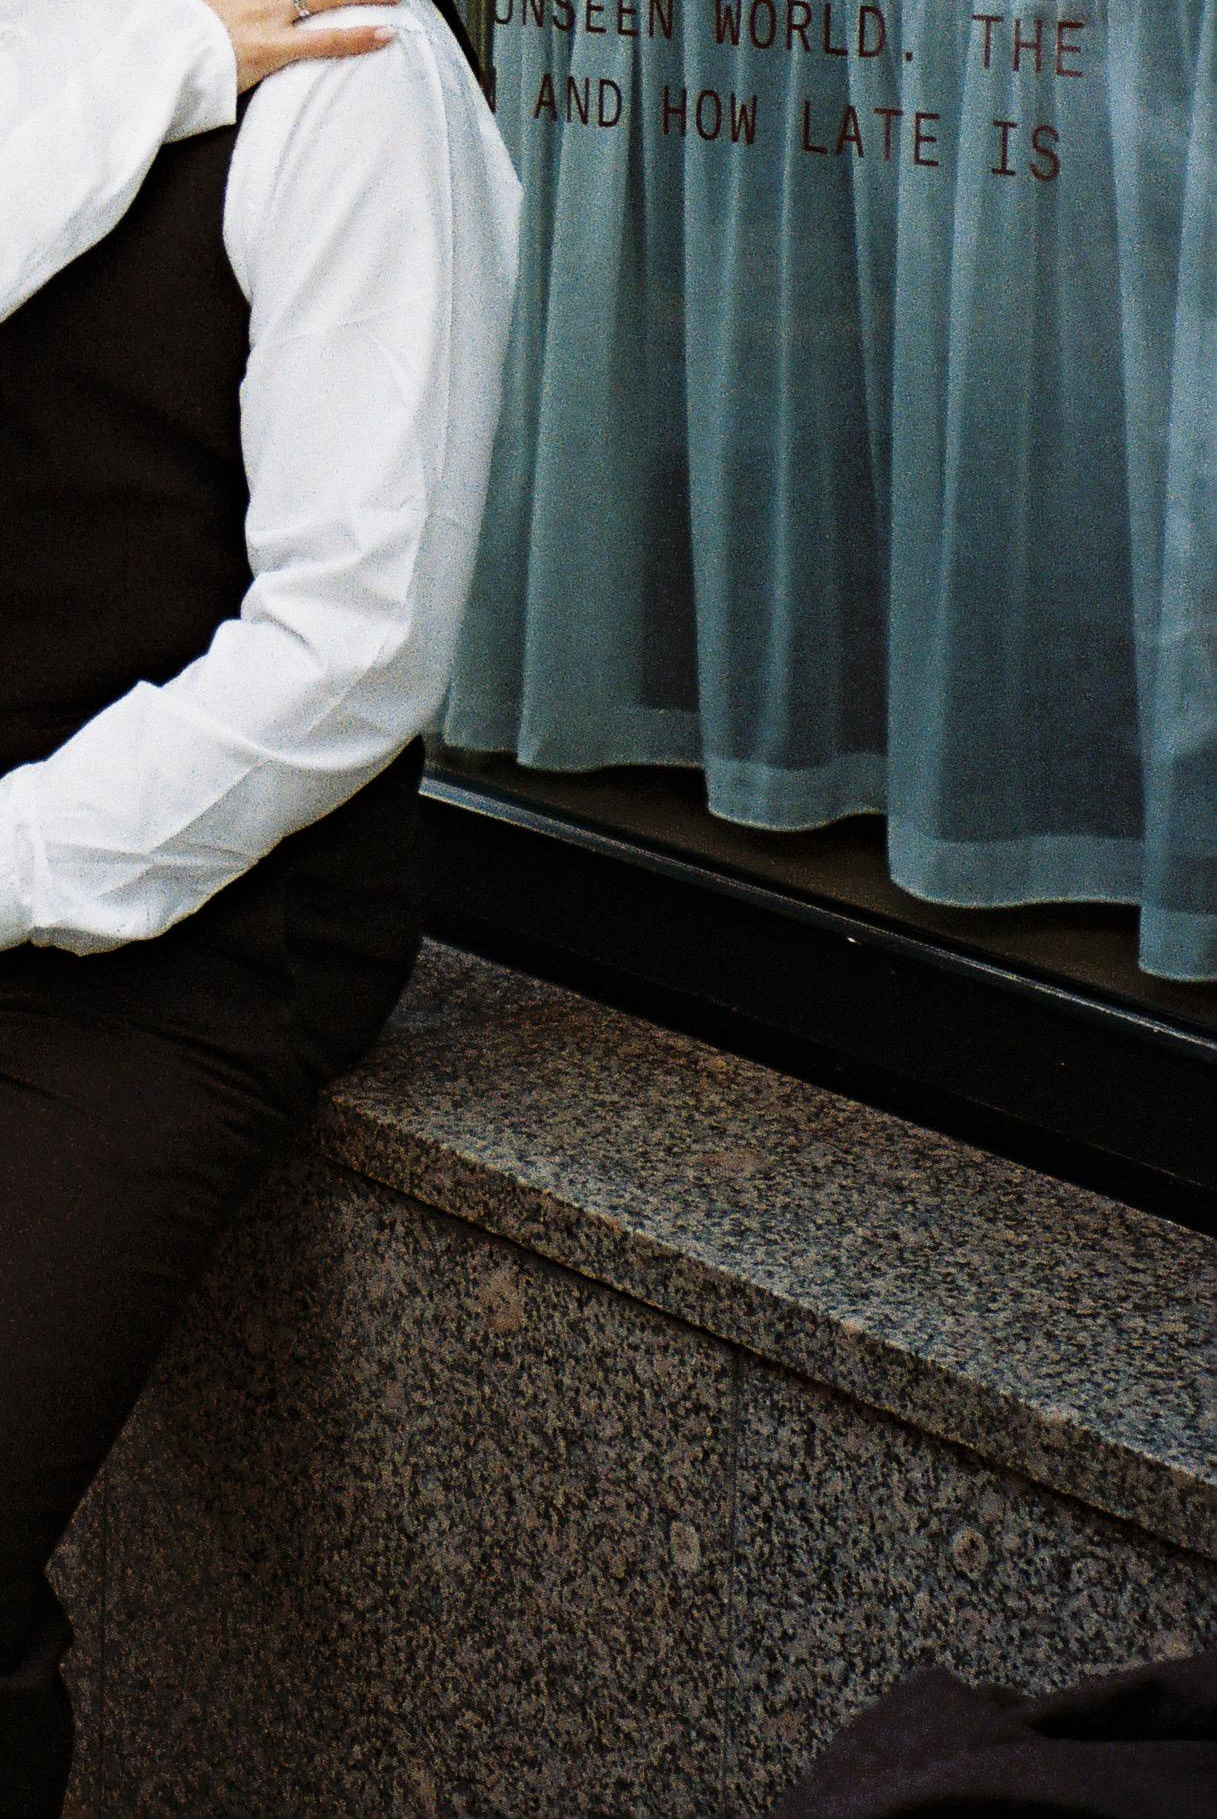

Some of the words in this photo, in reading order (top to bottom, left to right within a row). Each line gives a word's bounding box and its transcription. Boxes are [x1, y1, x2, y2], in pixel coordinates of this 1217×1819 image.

[972, 14, 1085, 78] THE
[534, 73, 623, 128] AND
[663, 87, 758, 146] HOW
[801, 100, 940, 168] LATE
[990, 119, 1061, 182] IS
